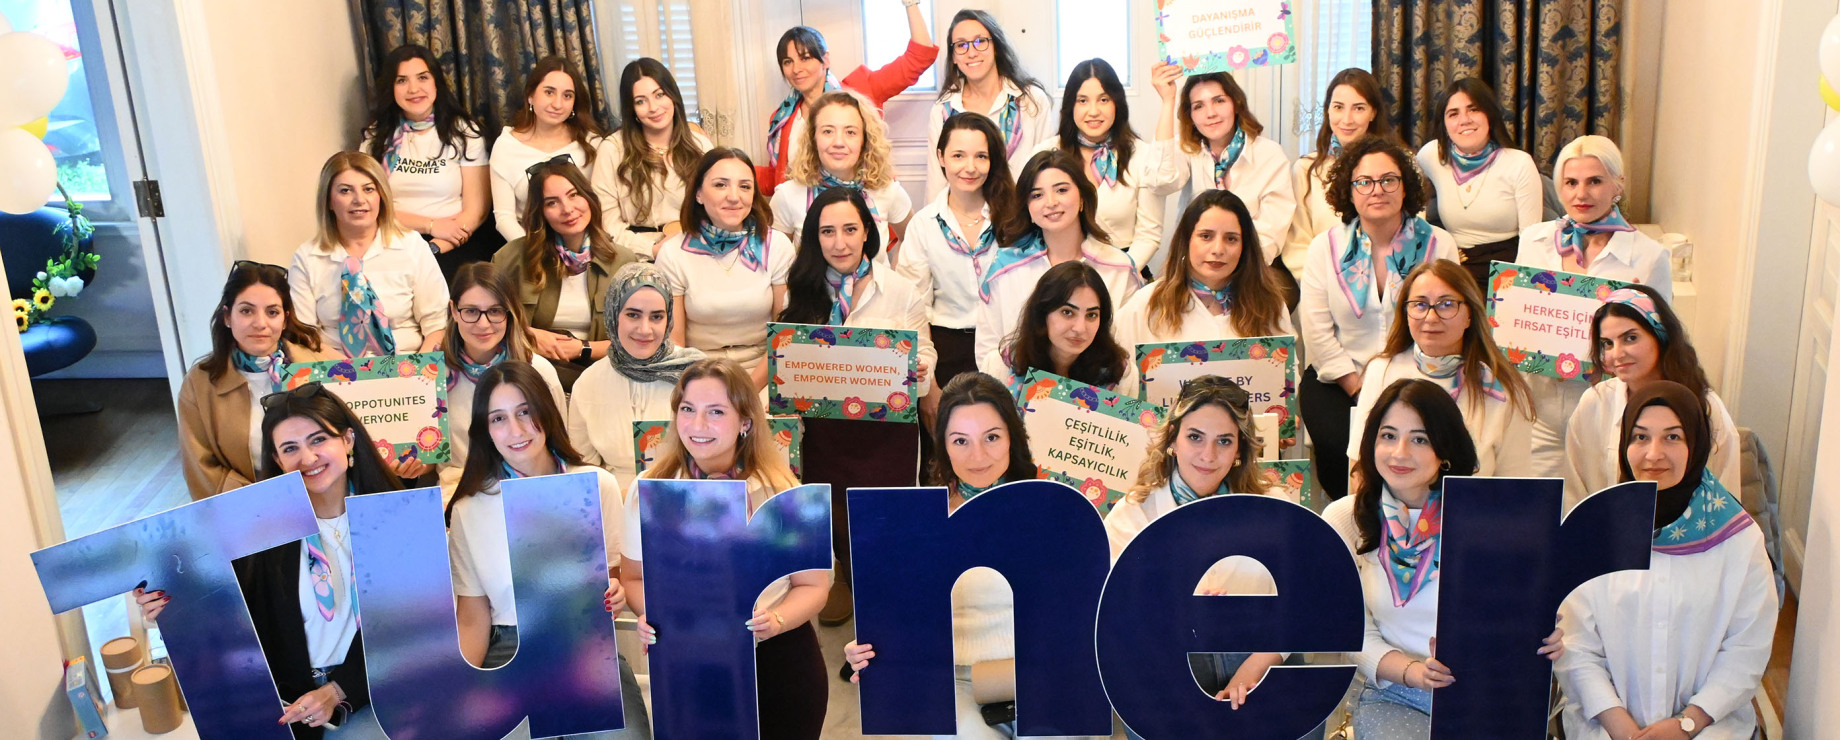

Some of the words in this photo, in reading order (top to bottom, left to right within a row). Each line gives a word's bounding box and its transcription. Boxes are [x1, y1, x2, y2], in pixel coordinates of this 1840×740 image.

[1192, 8, 1255, 24] DAYANIŞMA
[1188, 22, 1262, 39] GÜÇLENDİRİR
[396, 157, 447, 168] RANDMA'S
[1523, 304, 1569, 320] HERKES
[1514, 319, 1553, 333] FIRSAT
[785, 360, 853, 372] EMPOWERED
[855, 365, 900, 376] WOMEN,
[793, 374, 847, 385] EMPOWER
[849, 377, 892, 387] WOMEN
[1236, 376, 1253, 386] BY
[346, 395, 426, 410] OPPOTUNITES
[360, 412, 409, 425] ERYONE
[1065, 417, 1130, 447] ÇEŞİTLİLİK,
[1069, 436, 1115, 460] EŞİTLİK,
[1048, 447, 1129, 480] KAPSAYICILIK
[31, 470, 1657, 740] Turner
